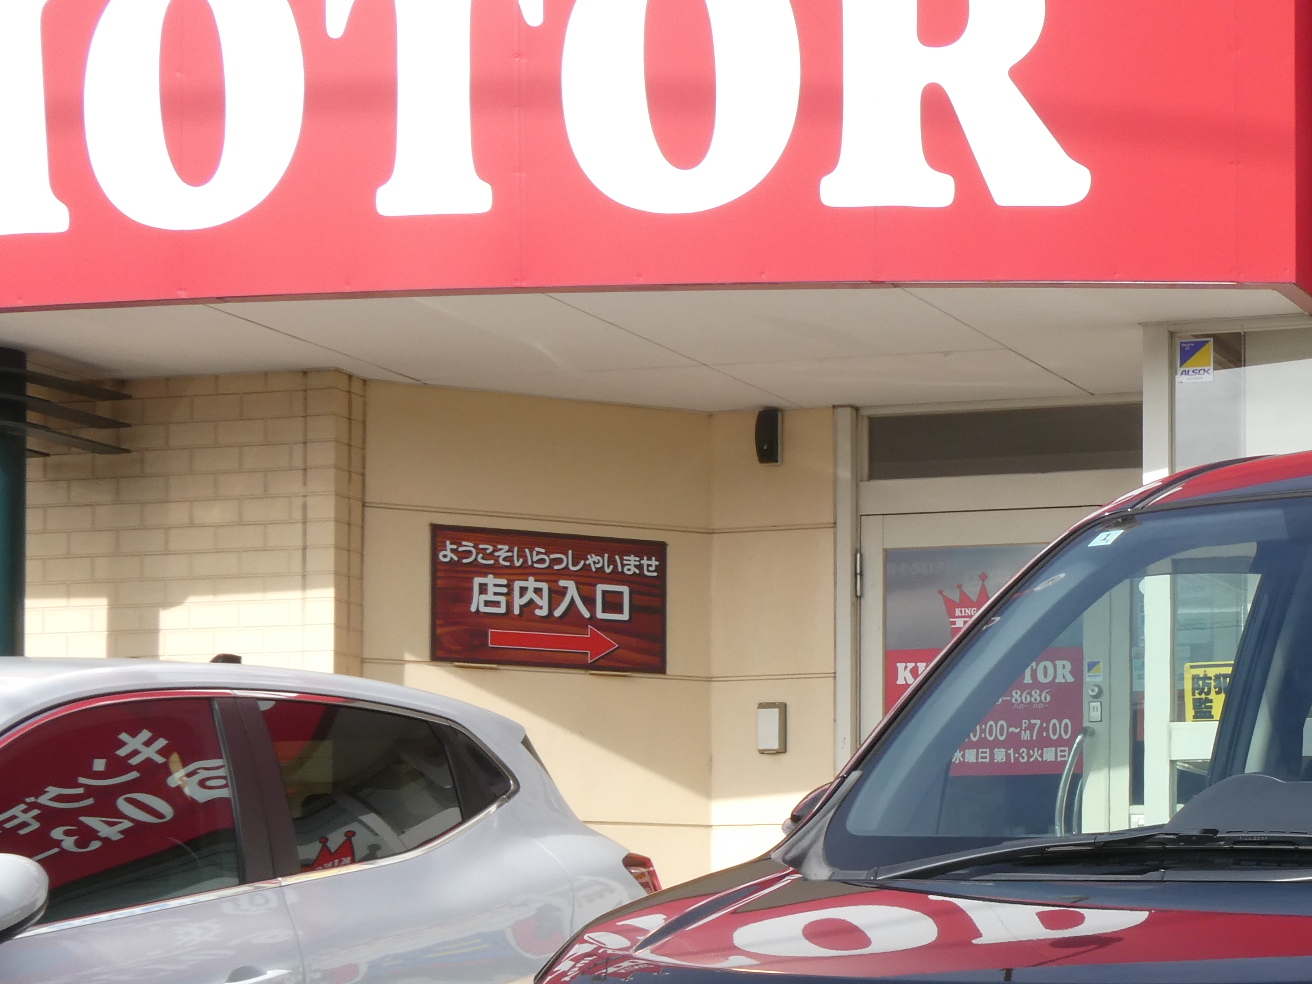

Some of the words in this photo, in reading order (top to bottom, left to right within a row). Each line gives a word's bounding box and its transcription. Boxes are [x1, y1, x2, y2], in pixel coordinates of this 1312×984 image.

[438, 540, 659, 577] ようこそいらっしゃいませ
[470, 574, 630, 621] 店内入口
[955, 608, 977, 616] KING
